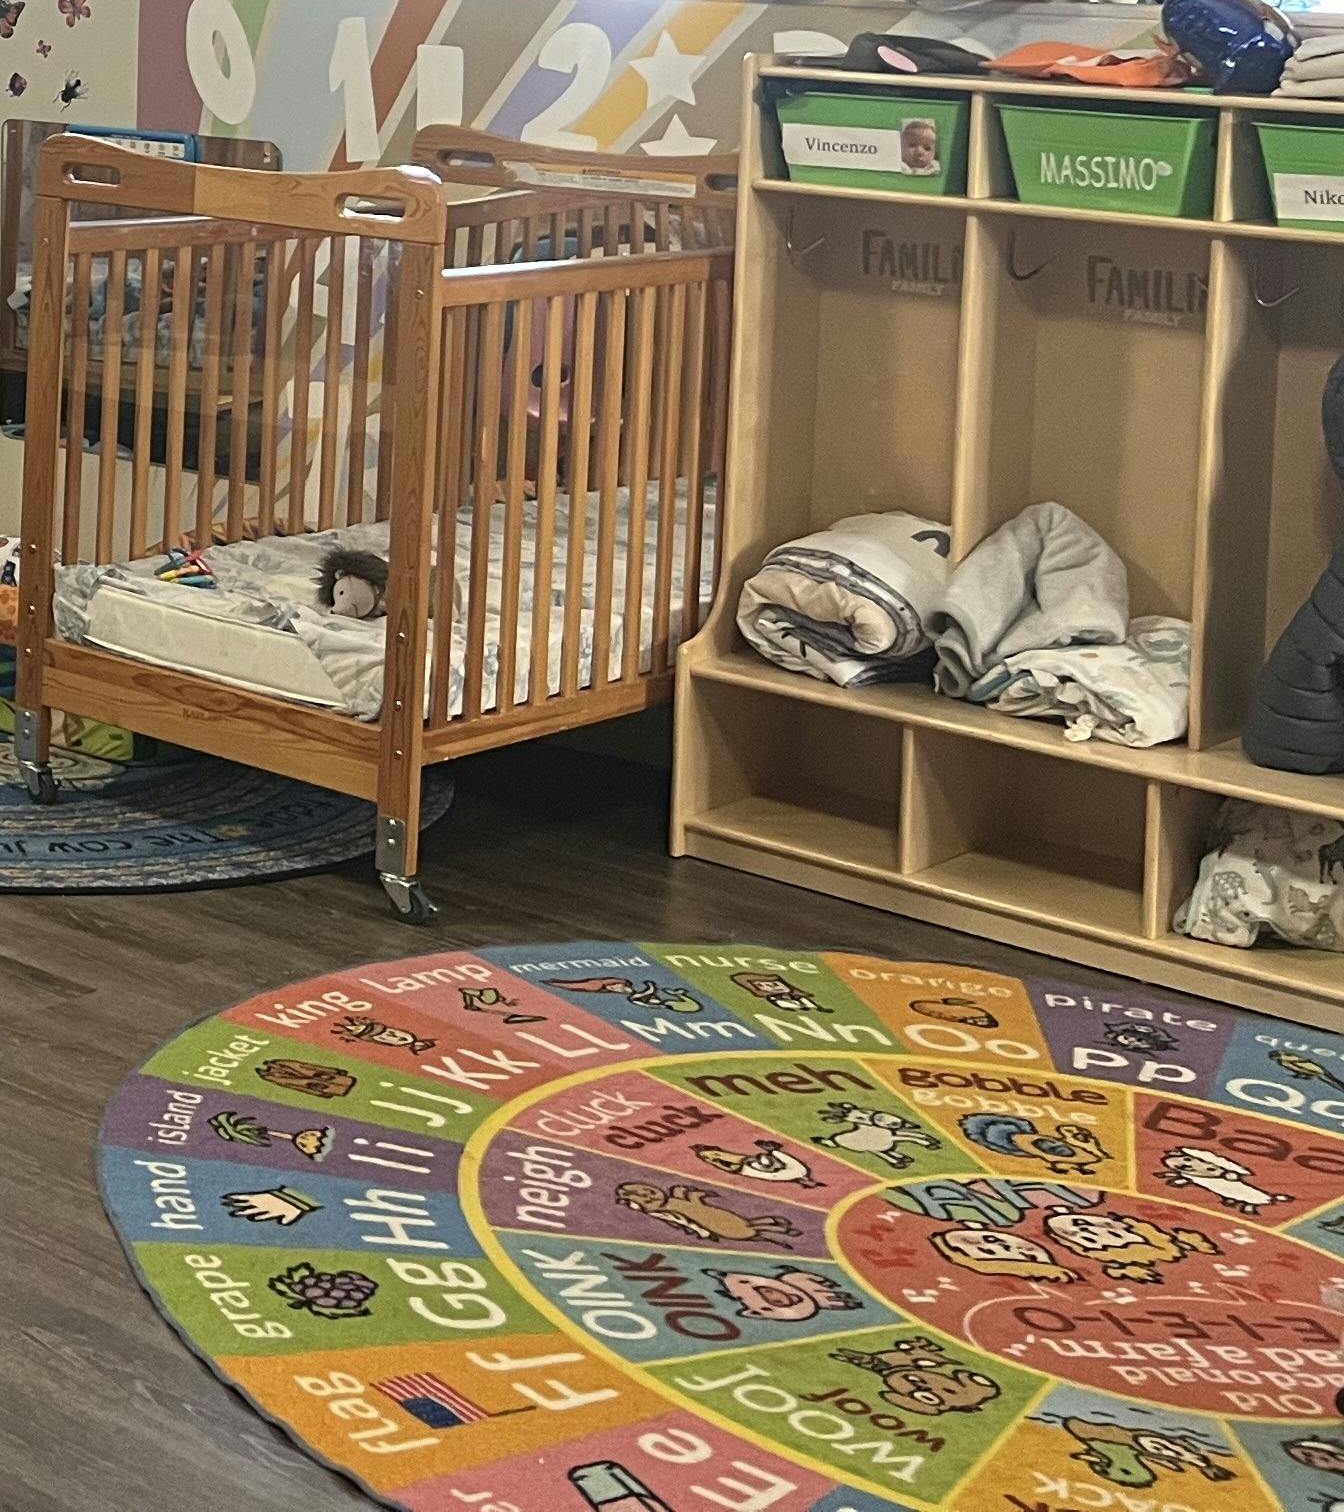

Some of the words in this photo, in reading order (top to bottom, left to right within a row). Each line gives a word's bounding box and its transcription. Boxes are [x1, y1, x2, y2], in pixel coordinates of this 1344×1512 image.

[328, 16, 381, 162] 1
[519, 22, 612, 153] 2
[804, 136, 878, 157] Vincenzo
[1040, 151, 1157, 191] MASSIMO
[49, 835, 134, 856] cow
[361, 959, 496, 995] lamp
[509, 953, 651, 976] mermaid
[665, 953, 821, 976] nurse
[847, 966, 1014, 999] orange
[255, 988, 373, 1031] king
[620, 1014, 759, 1043] Mm
[753, 1012, 894, 1047] Nn
[1043, 992, 1218, 1033] pirate
[180, 1033, 271, 1087] jacket
[903, 1023, 1042, 1061] Oo
[421, 1044, 543, 1092] Kk
[685, 1063, 876, 1099] meh
[896, 1066, 1110, 1107] gobble
[1071, 1046, 1198, 1084] Pp
[147, 1089, 205, 1147] island
[369, 1081, 475, 1129] Jj
[537, 1087, 656, 1138] cluck
[602, 1102, 725, 1150] cluck
[910, 1089, 1099, 1127] gobble
[132, 1159, 205, 1232] hand
[504, 1143, 594, 1230] neigh
[346, 1189, 452, 1251] Hh
[185, 1252, 294, 1341] grape
[387, 1255, 508, 1331] Gg
[520, 1247, 659, 1341] OINK
[600, 1250, 743, 1343] OINK
[464, 1350, 622, 1412] Ff
[1108, 1364, 1344, 1394] acdonald
[1254, 1346, 1344, 1371] ad
[293, 1369, 443, 1456] flag
[671, 1364, 925, 1485] woof
[799, 1387, 946, 1454] woof
[1219, 1390, 1323, 1418] Old
[637, 1427, 799, 1512] Ee
